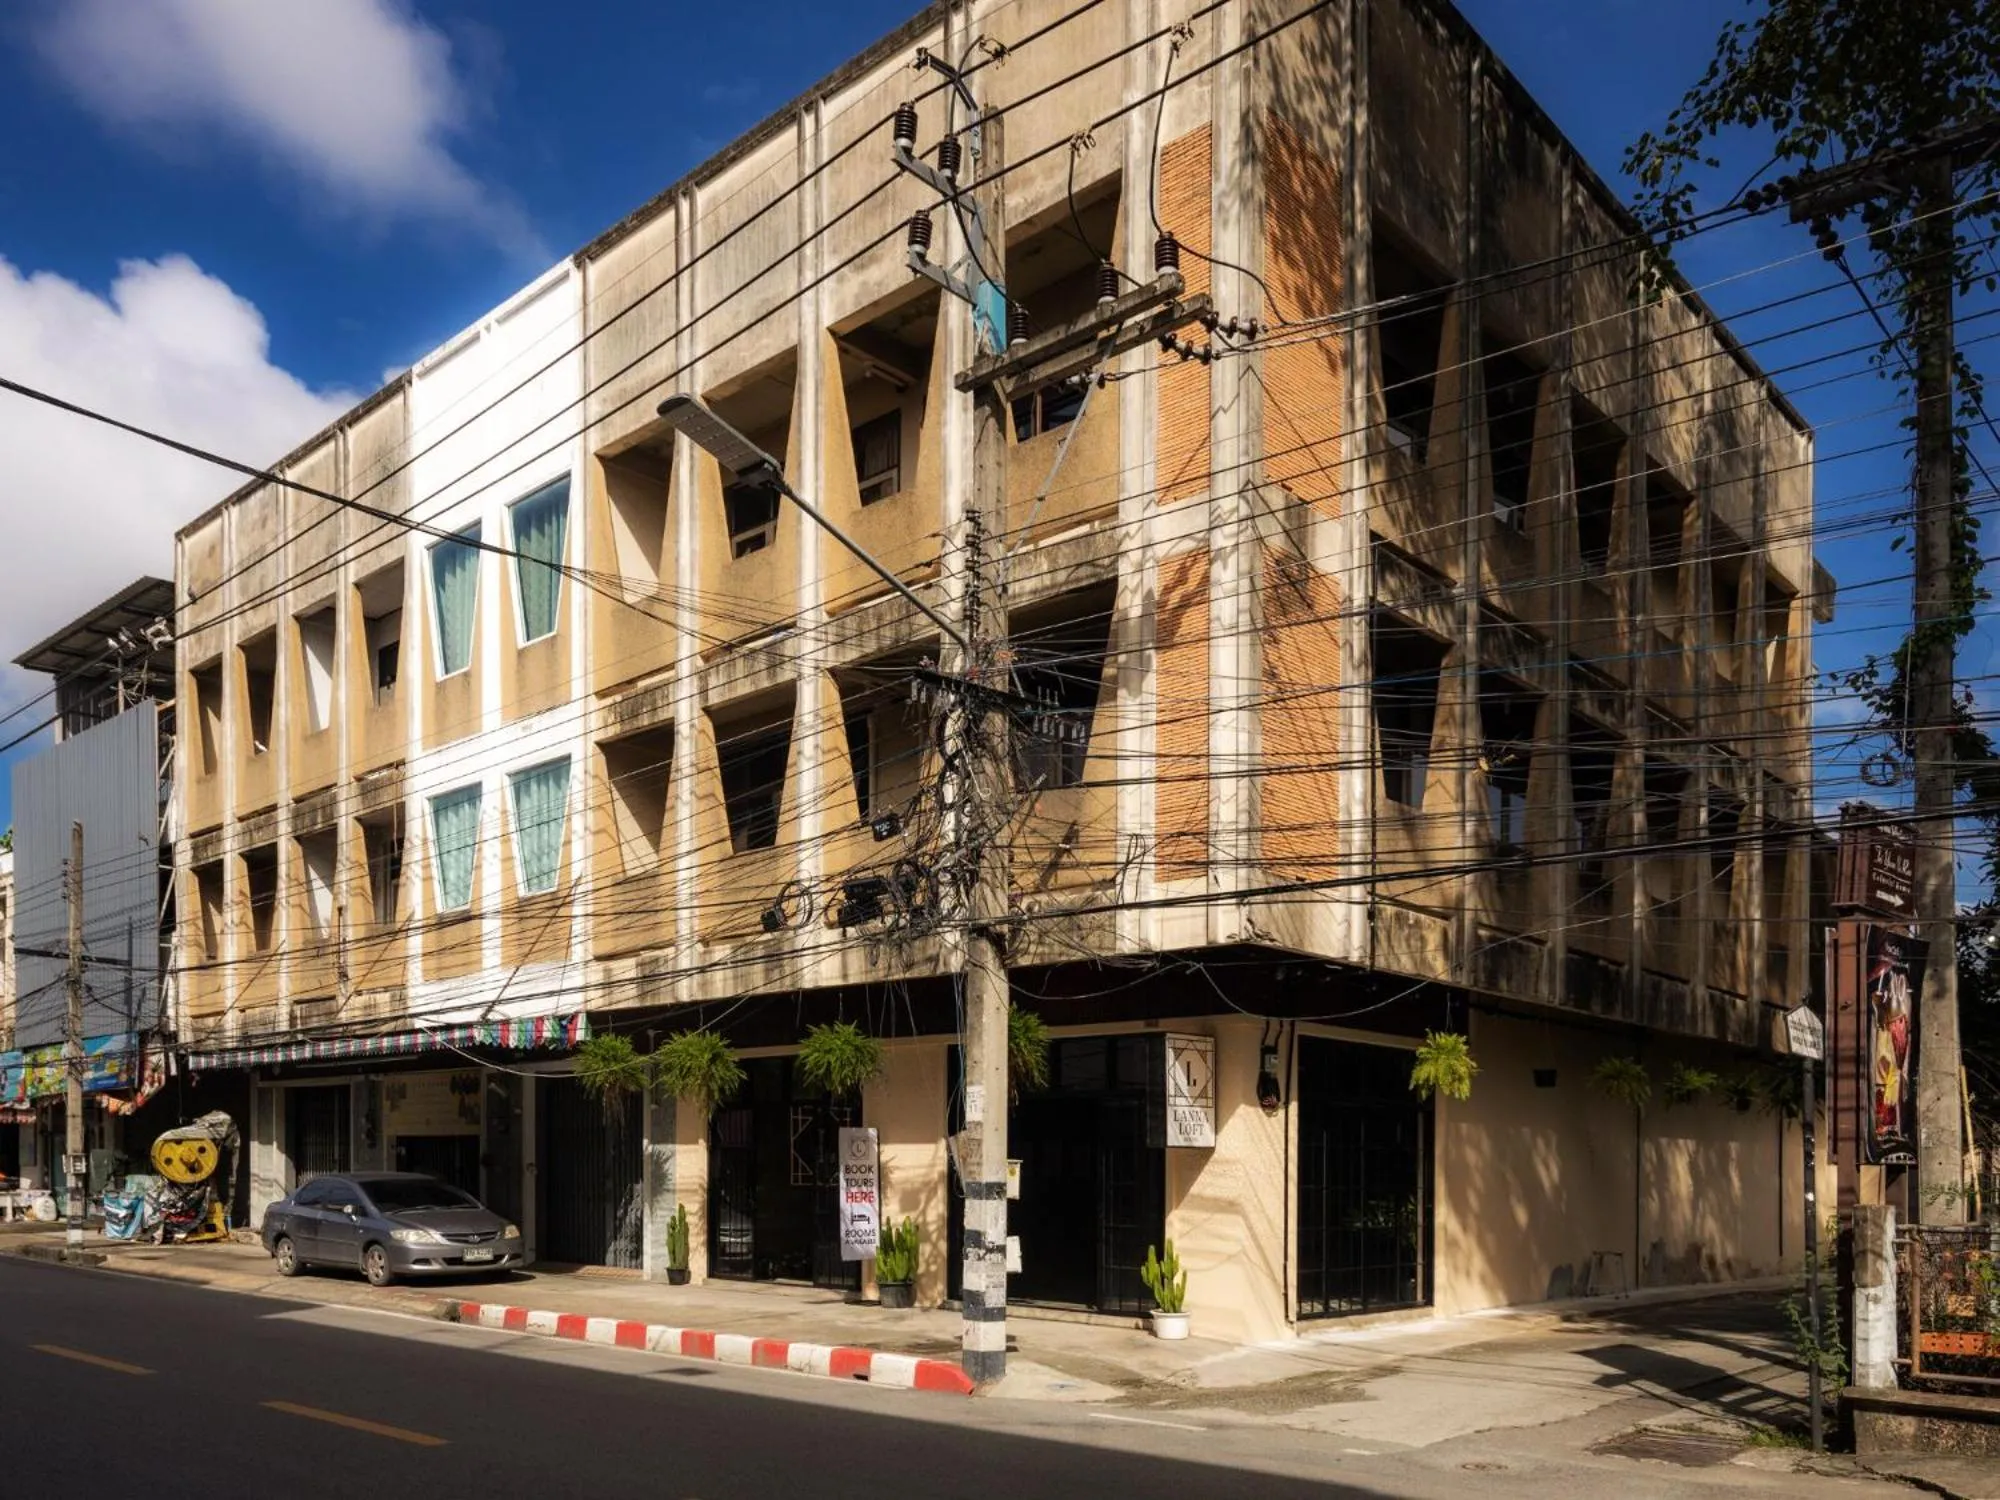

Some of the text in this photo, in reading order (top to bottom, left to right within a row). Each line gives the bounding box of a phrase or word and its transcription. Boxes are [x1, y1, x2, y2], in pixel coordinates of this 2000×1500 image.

[1173, 1109, 1209, 1122] LANNA
[1179, 1122, 1204, 1136] LOFT
[845, 1164, 874, 1175] BOOK
[845, 1178, 874, 1188] TOURS
[845, 1191, 875, 1204] HERE
[845, 1229, 876, 1239] ROOMS
